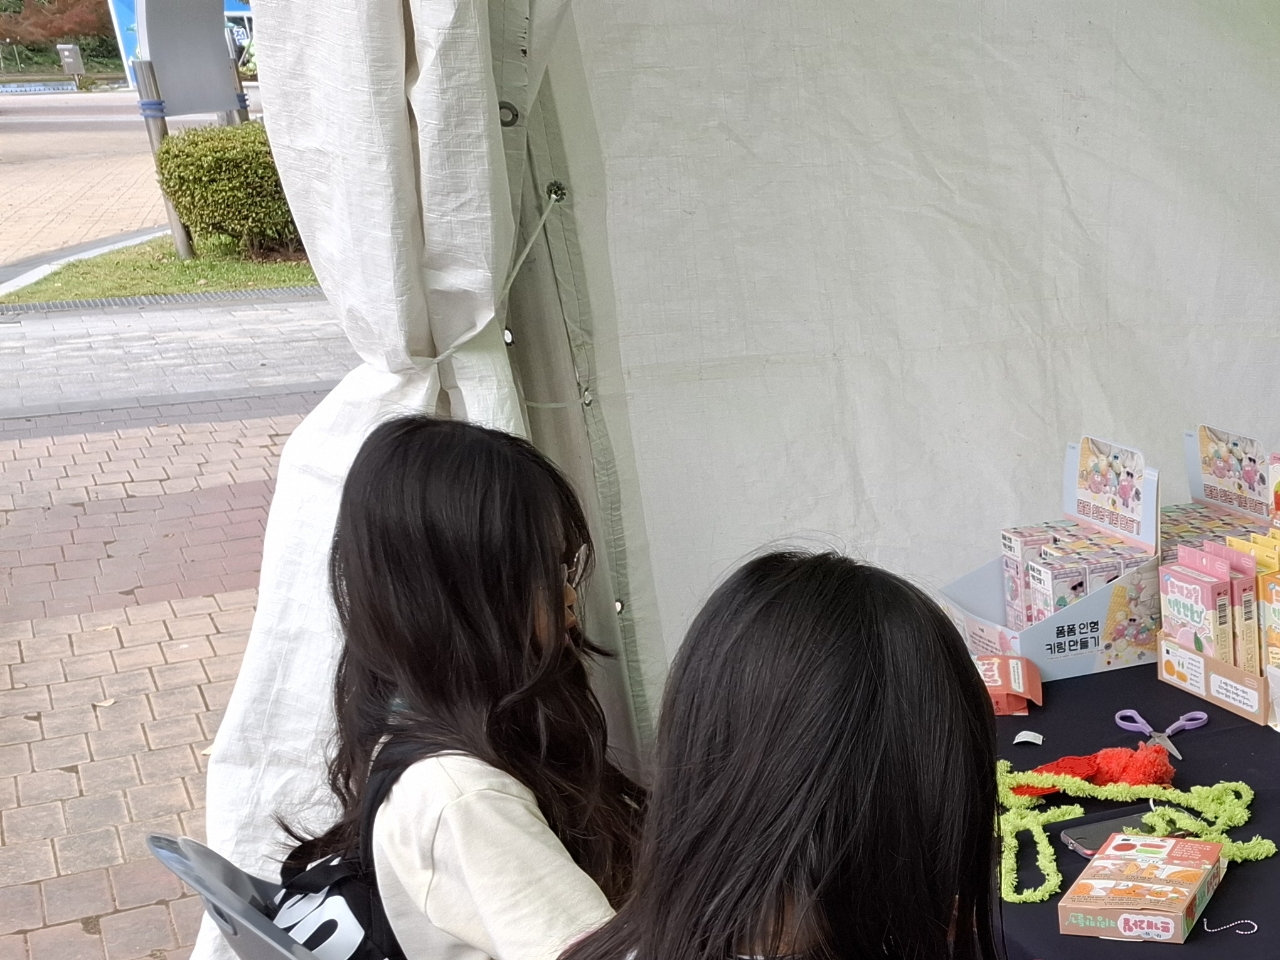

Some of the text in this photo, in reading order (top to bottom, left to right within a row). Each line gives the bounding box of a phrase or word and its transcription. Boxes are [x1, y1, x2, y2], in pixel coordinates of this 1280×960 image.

[1078, 620, 1099, 634] 인형
[1045, 635, 1100, 655] 키링 만들기
